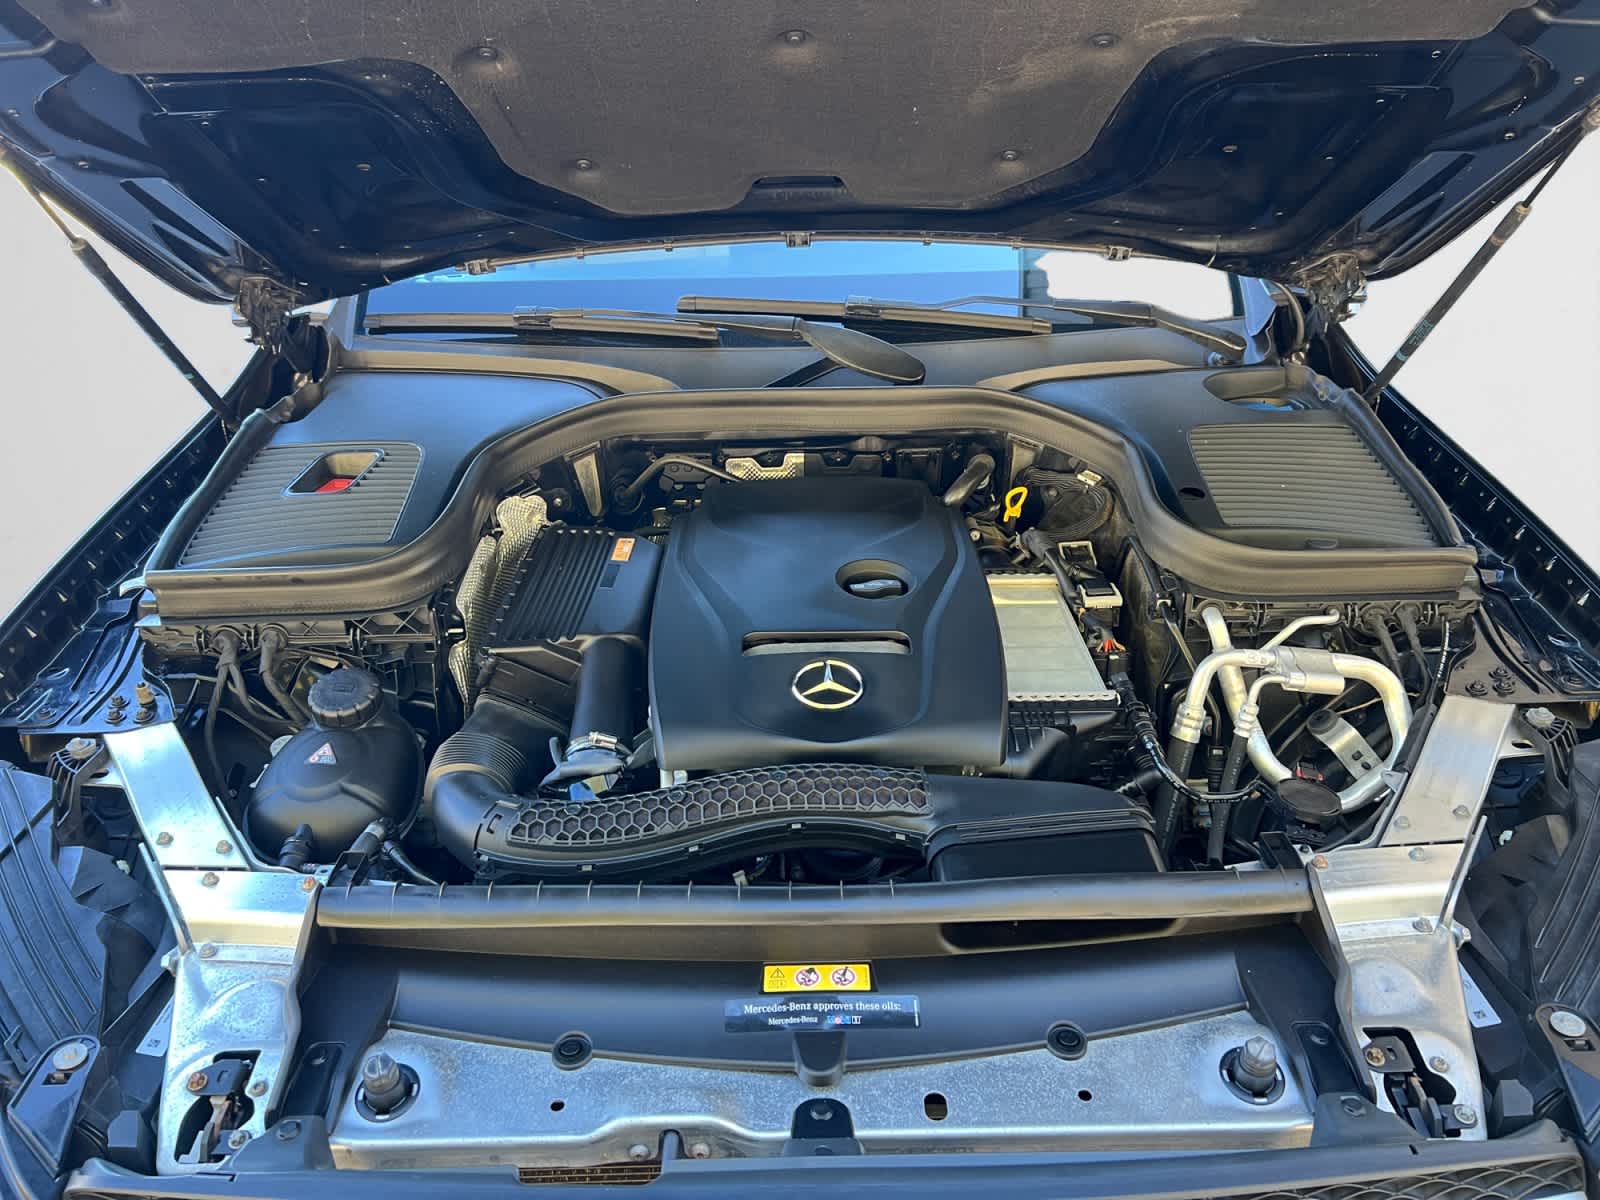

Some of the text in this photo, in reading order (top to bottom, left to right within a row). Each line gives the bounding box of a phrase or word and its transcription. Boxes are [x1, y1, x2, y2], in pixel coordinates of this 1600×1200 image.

[744, 1002, 811, 1014] Mercedes-Benz
[813, 1002, 854, 1012] approves
[855, 1001, 880, 1011] these
[767, 1016, 818, 1026] Mercedes-Benz
